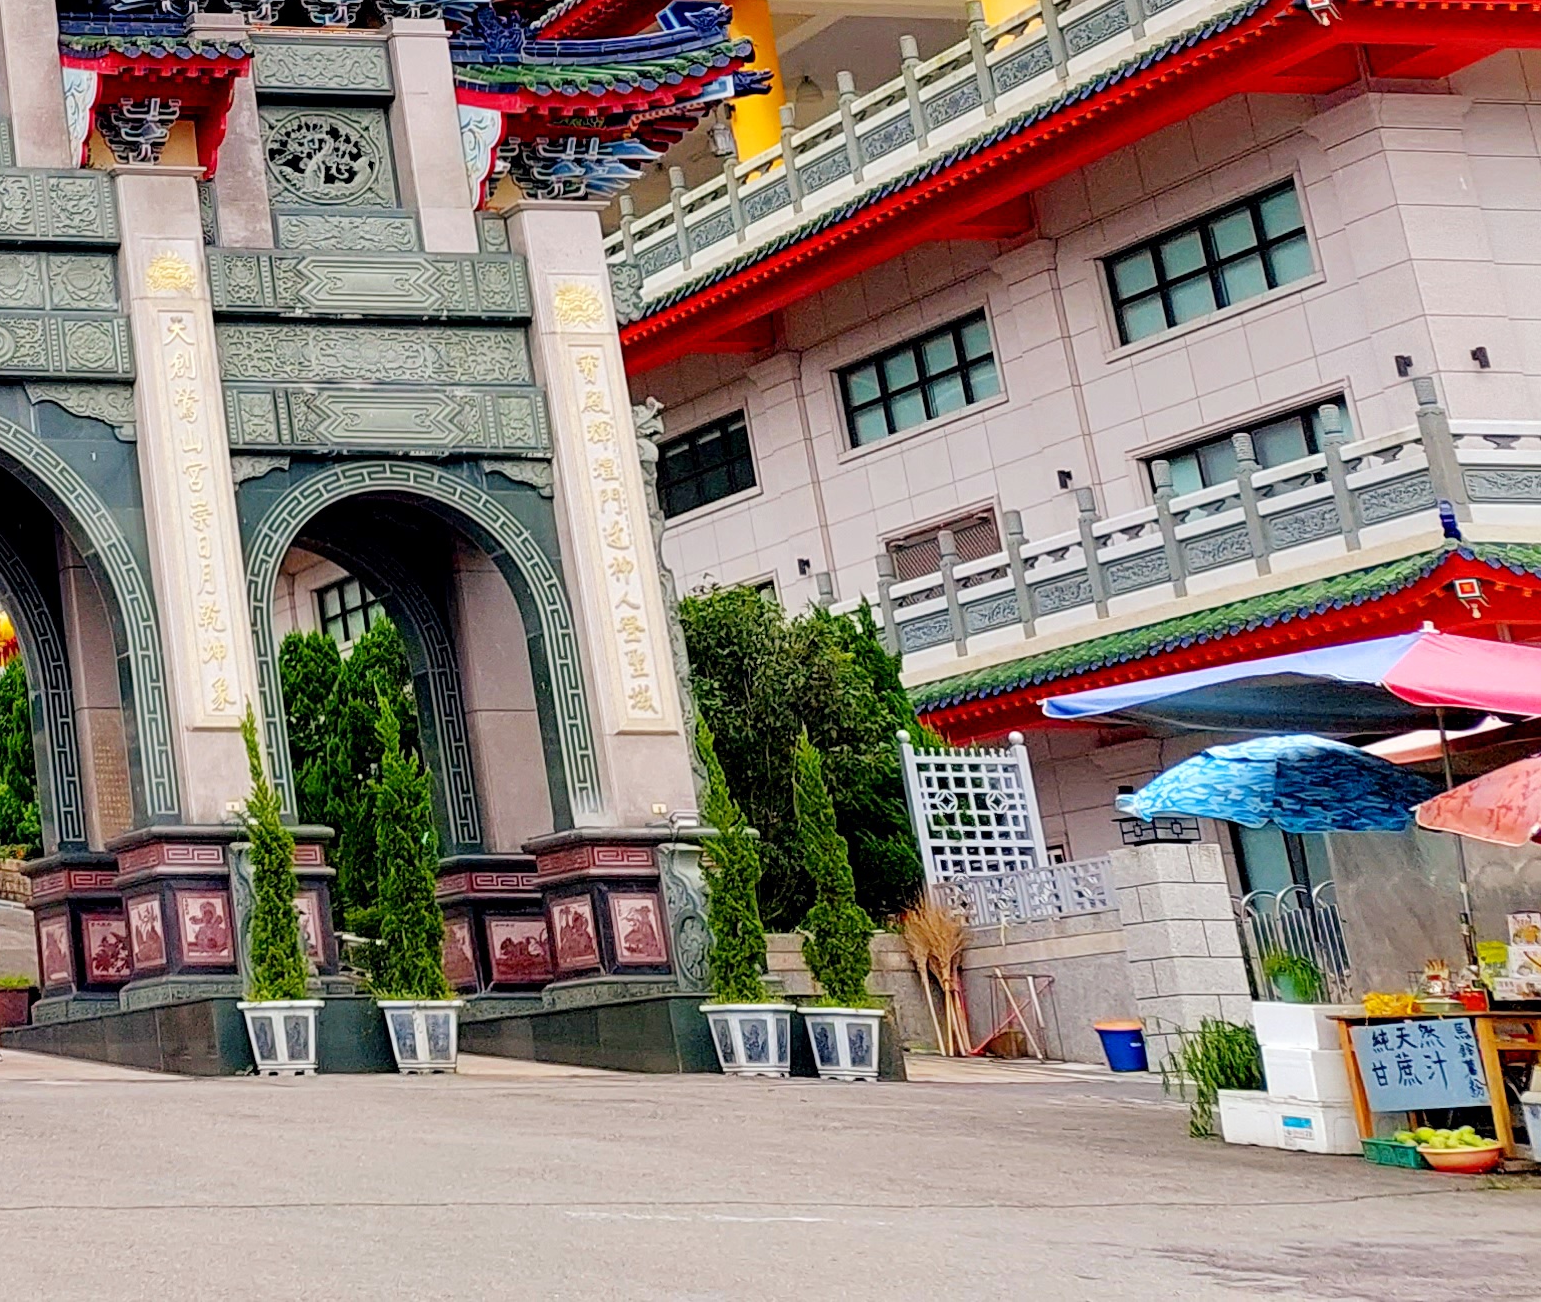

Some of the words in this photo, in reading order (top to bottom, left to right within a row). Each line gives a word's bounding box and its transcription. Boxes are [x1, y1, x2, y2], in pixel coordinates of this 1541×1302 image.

[1372, 1024, 1446, 1053] 純天然
[1372, 1050, 1447, 1090] 甘蔗汁
